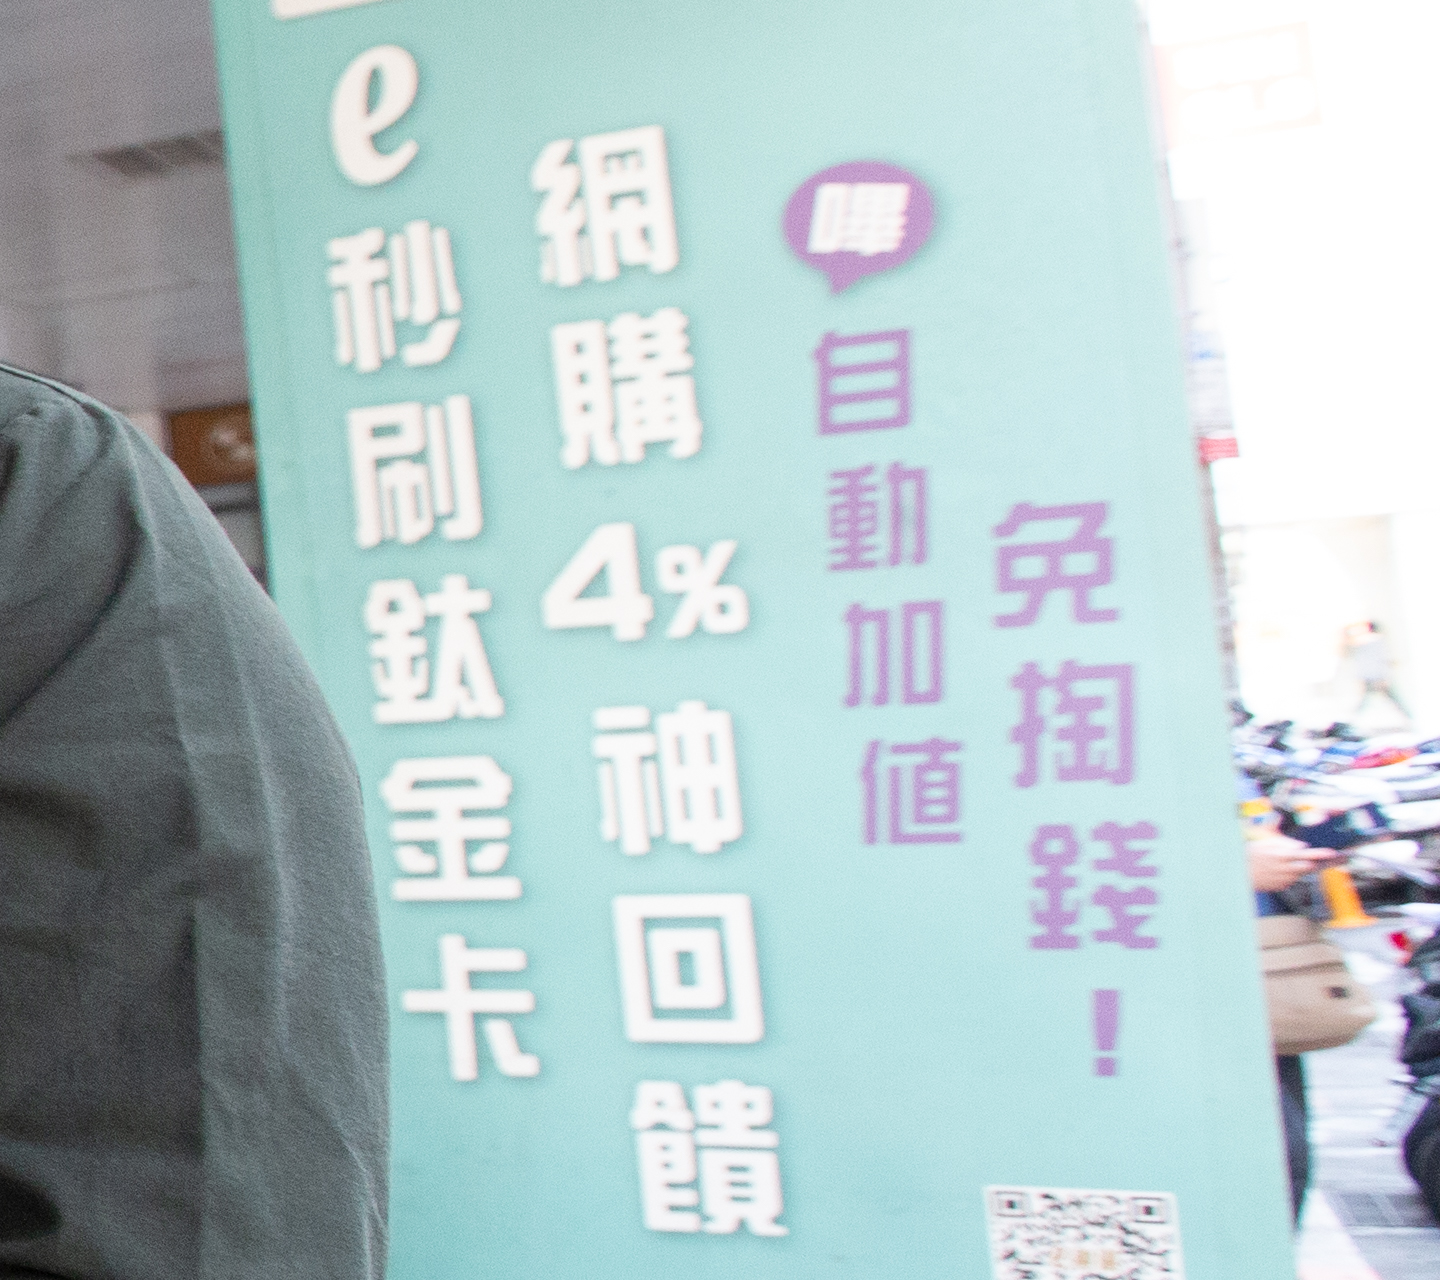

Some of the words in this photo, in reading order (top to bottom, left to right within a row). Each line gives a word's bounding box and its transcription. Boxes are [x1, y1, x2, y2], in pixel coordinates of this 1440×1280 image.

[328, 43, 539, 1081] e秒刷鈦金卡
[530, 123, 789, 1238] 網購4%神回饋
[812, 327, 964, 845] 自動加值
